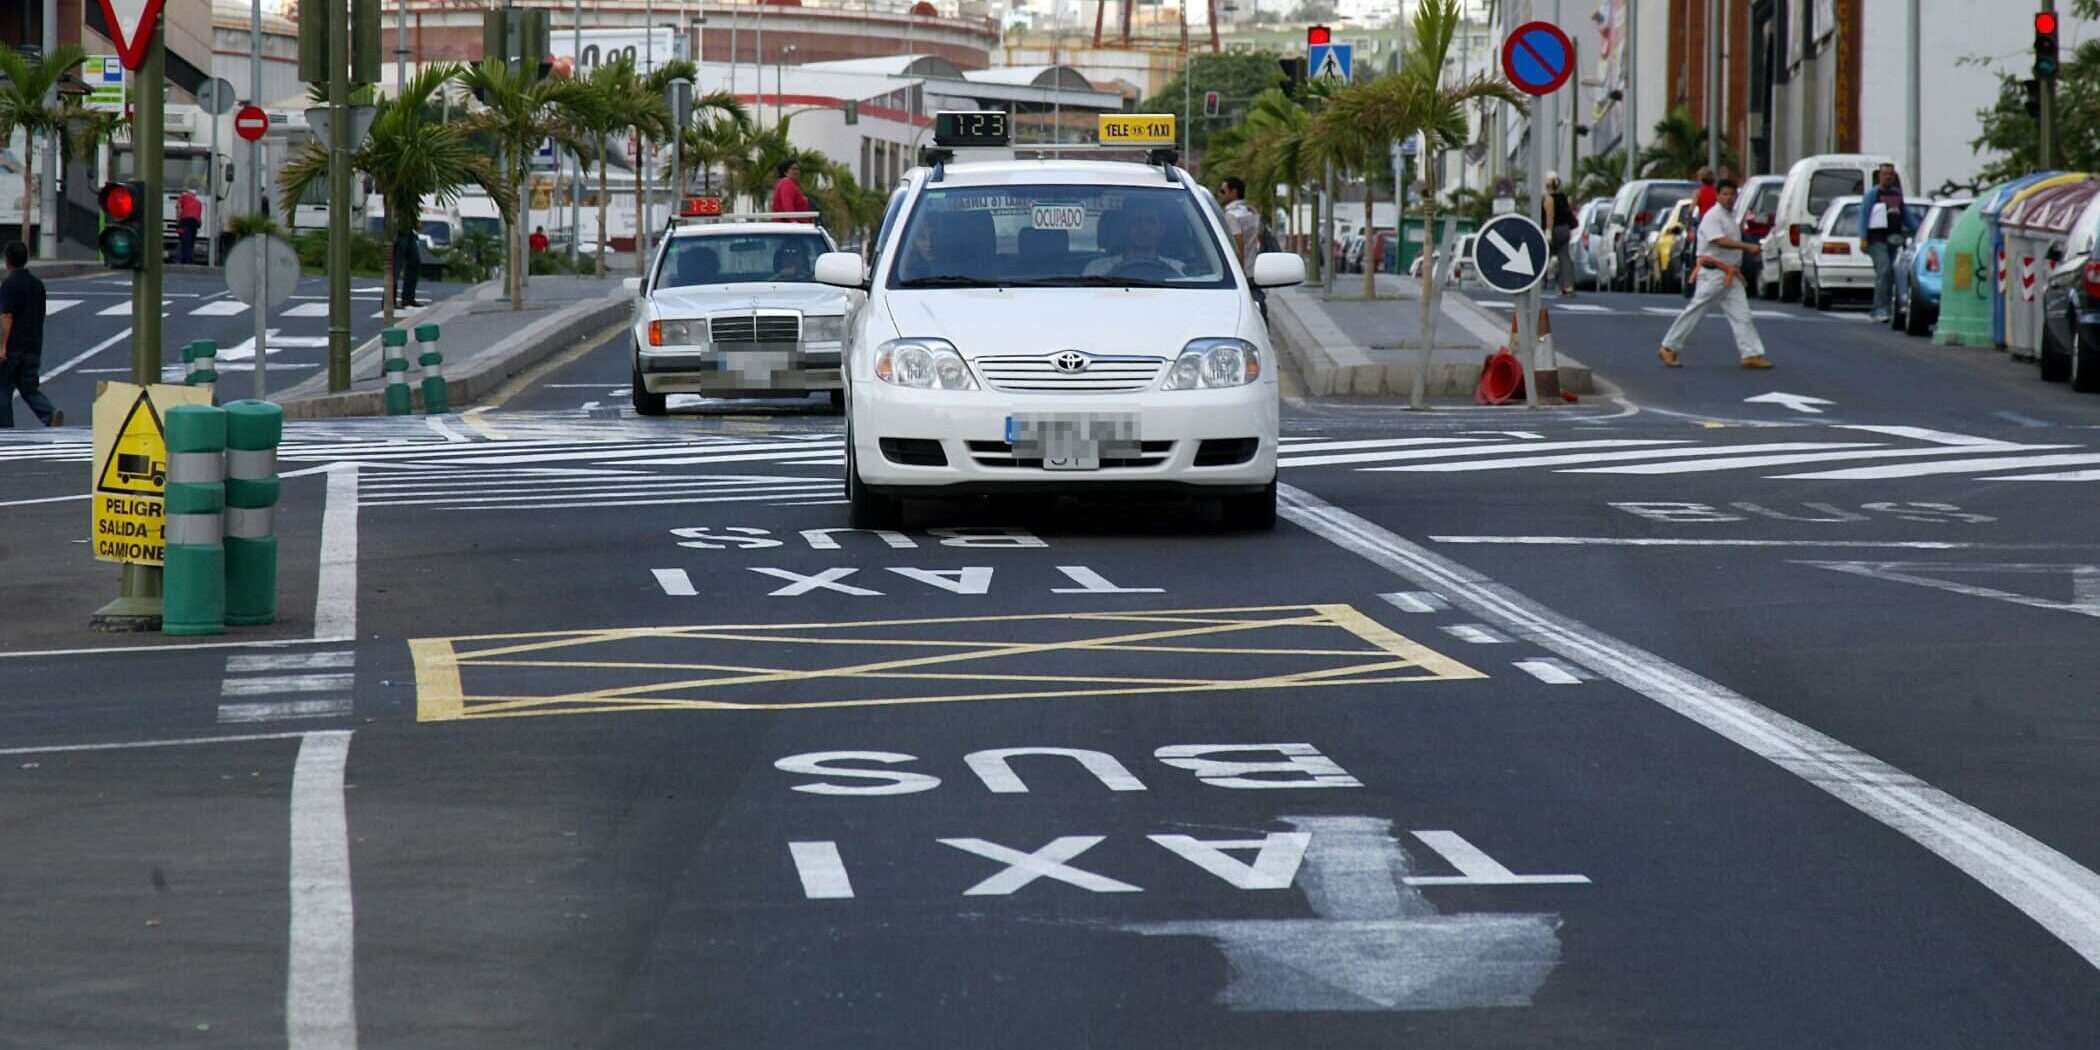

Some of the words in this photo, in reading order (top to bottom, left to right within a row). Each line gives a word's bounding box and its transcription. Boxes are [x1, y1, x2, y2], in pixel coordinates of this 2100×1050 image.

[1105, 123, 1129, 137] TELE
[1147, 123, 1170, 137] TAXI
[1035, 208, 1082, 228] OCUPADO
[106, 498, 165, 518] PELIGR
[1608, 502, 1997, 523] BUS
[99, 518, 148, 538] SALIDA
[669, 527, 1049, 549] BUS
[99, 540, 164, 560] CAMIONE
[650, 566, 1166, 596] TAXI
[774, 743, 1366, 796] BUS
[788, 829, 1593, 899] TAXI
